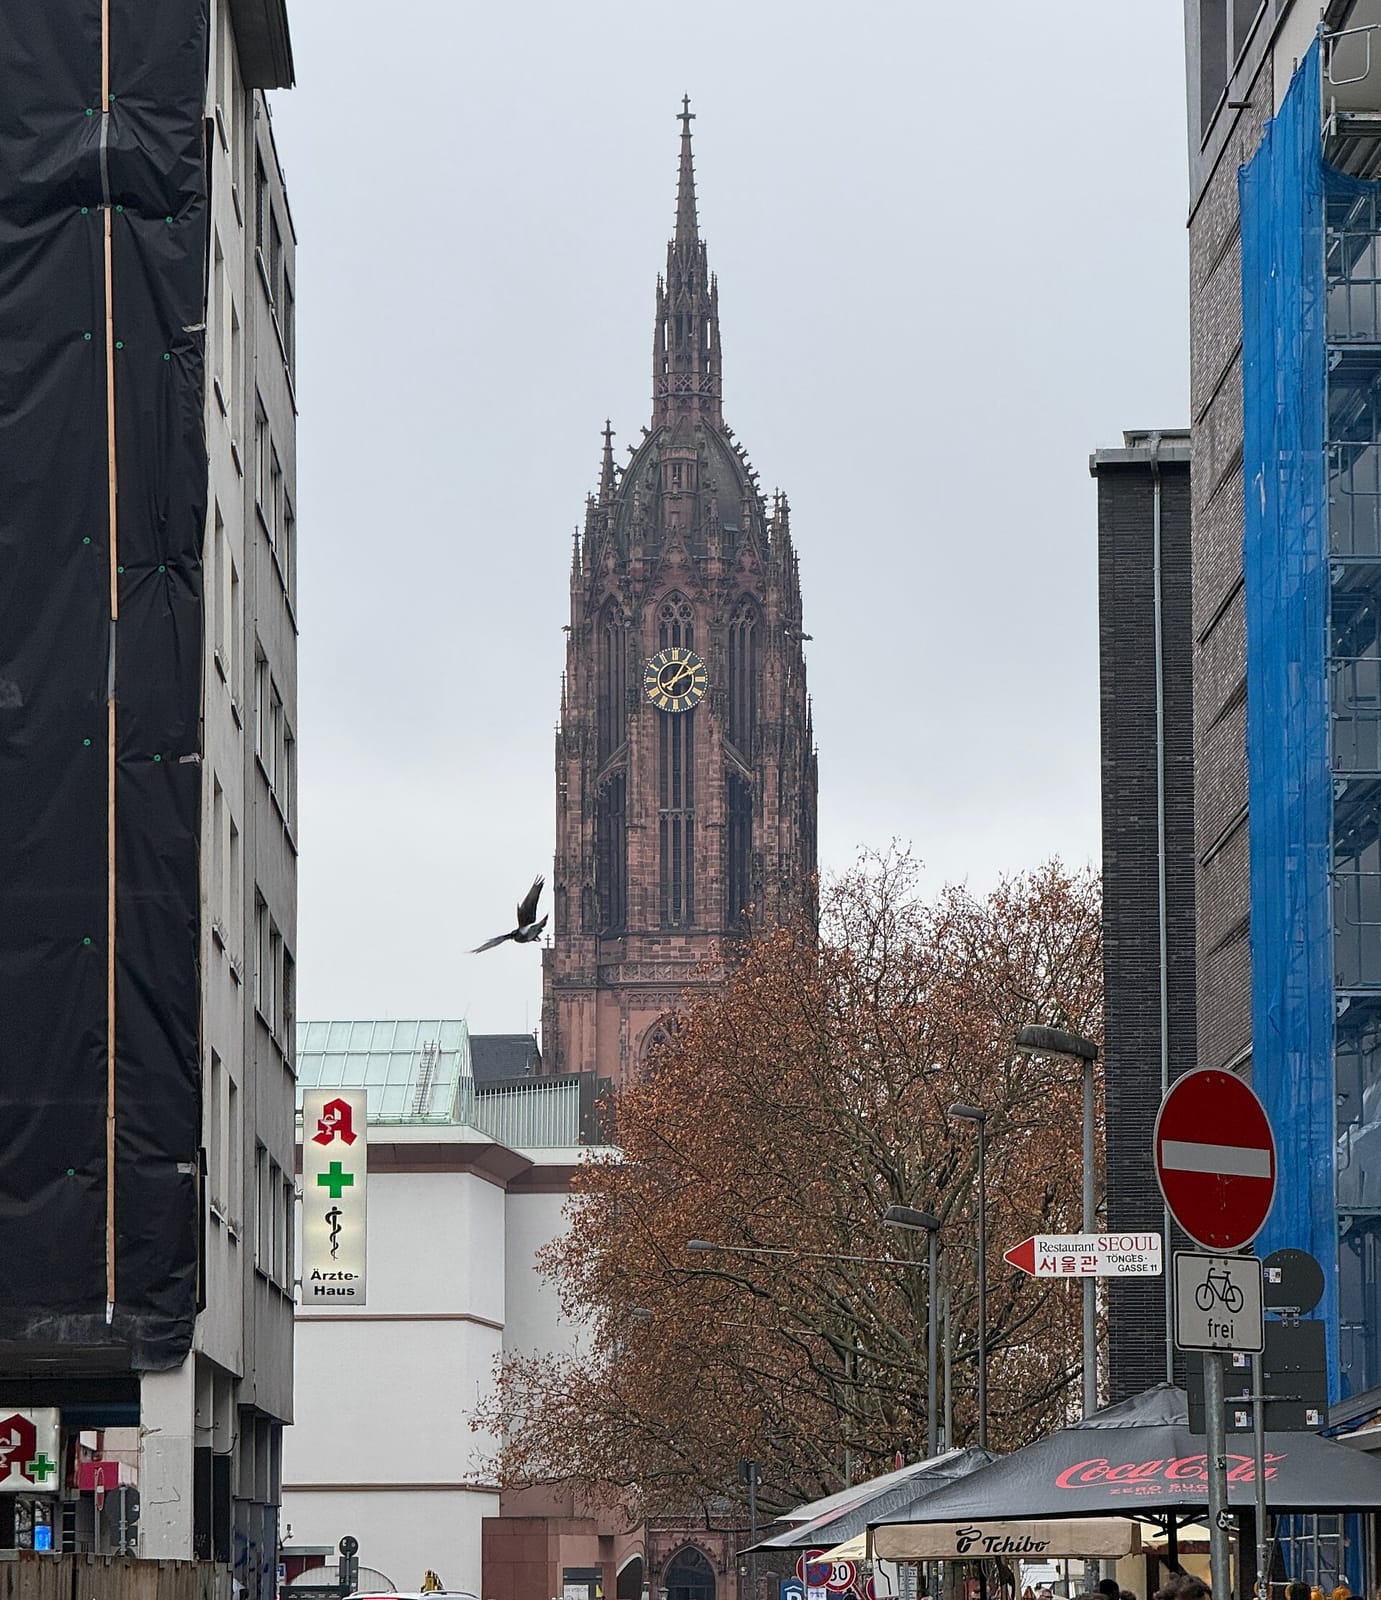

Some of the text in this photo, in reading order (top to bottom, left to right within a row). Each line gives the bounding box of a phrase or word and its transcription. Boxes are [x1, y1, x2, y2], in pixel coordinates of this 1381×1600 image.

[1039, 1236, 1158, 1253] Restaurant SEOUL
[1039, 1255, 1099, 1273] 서울관
[1118, 1263, 1158, 1272] GASSE 11
[310, 1268, 359, 1281] Ärzte-
[313, 1285, 356, 1296] Haus
[1207, 1318, 1234, 1340] frei
[982, 1536, 1051, 1553] Tchibo
